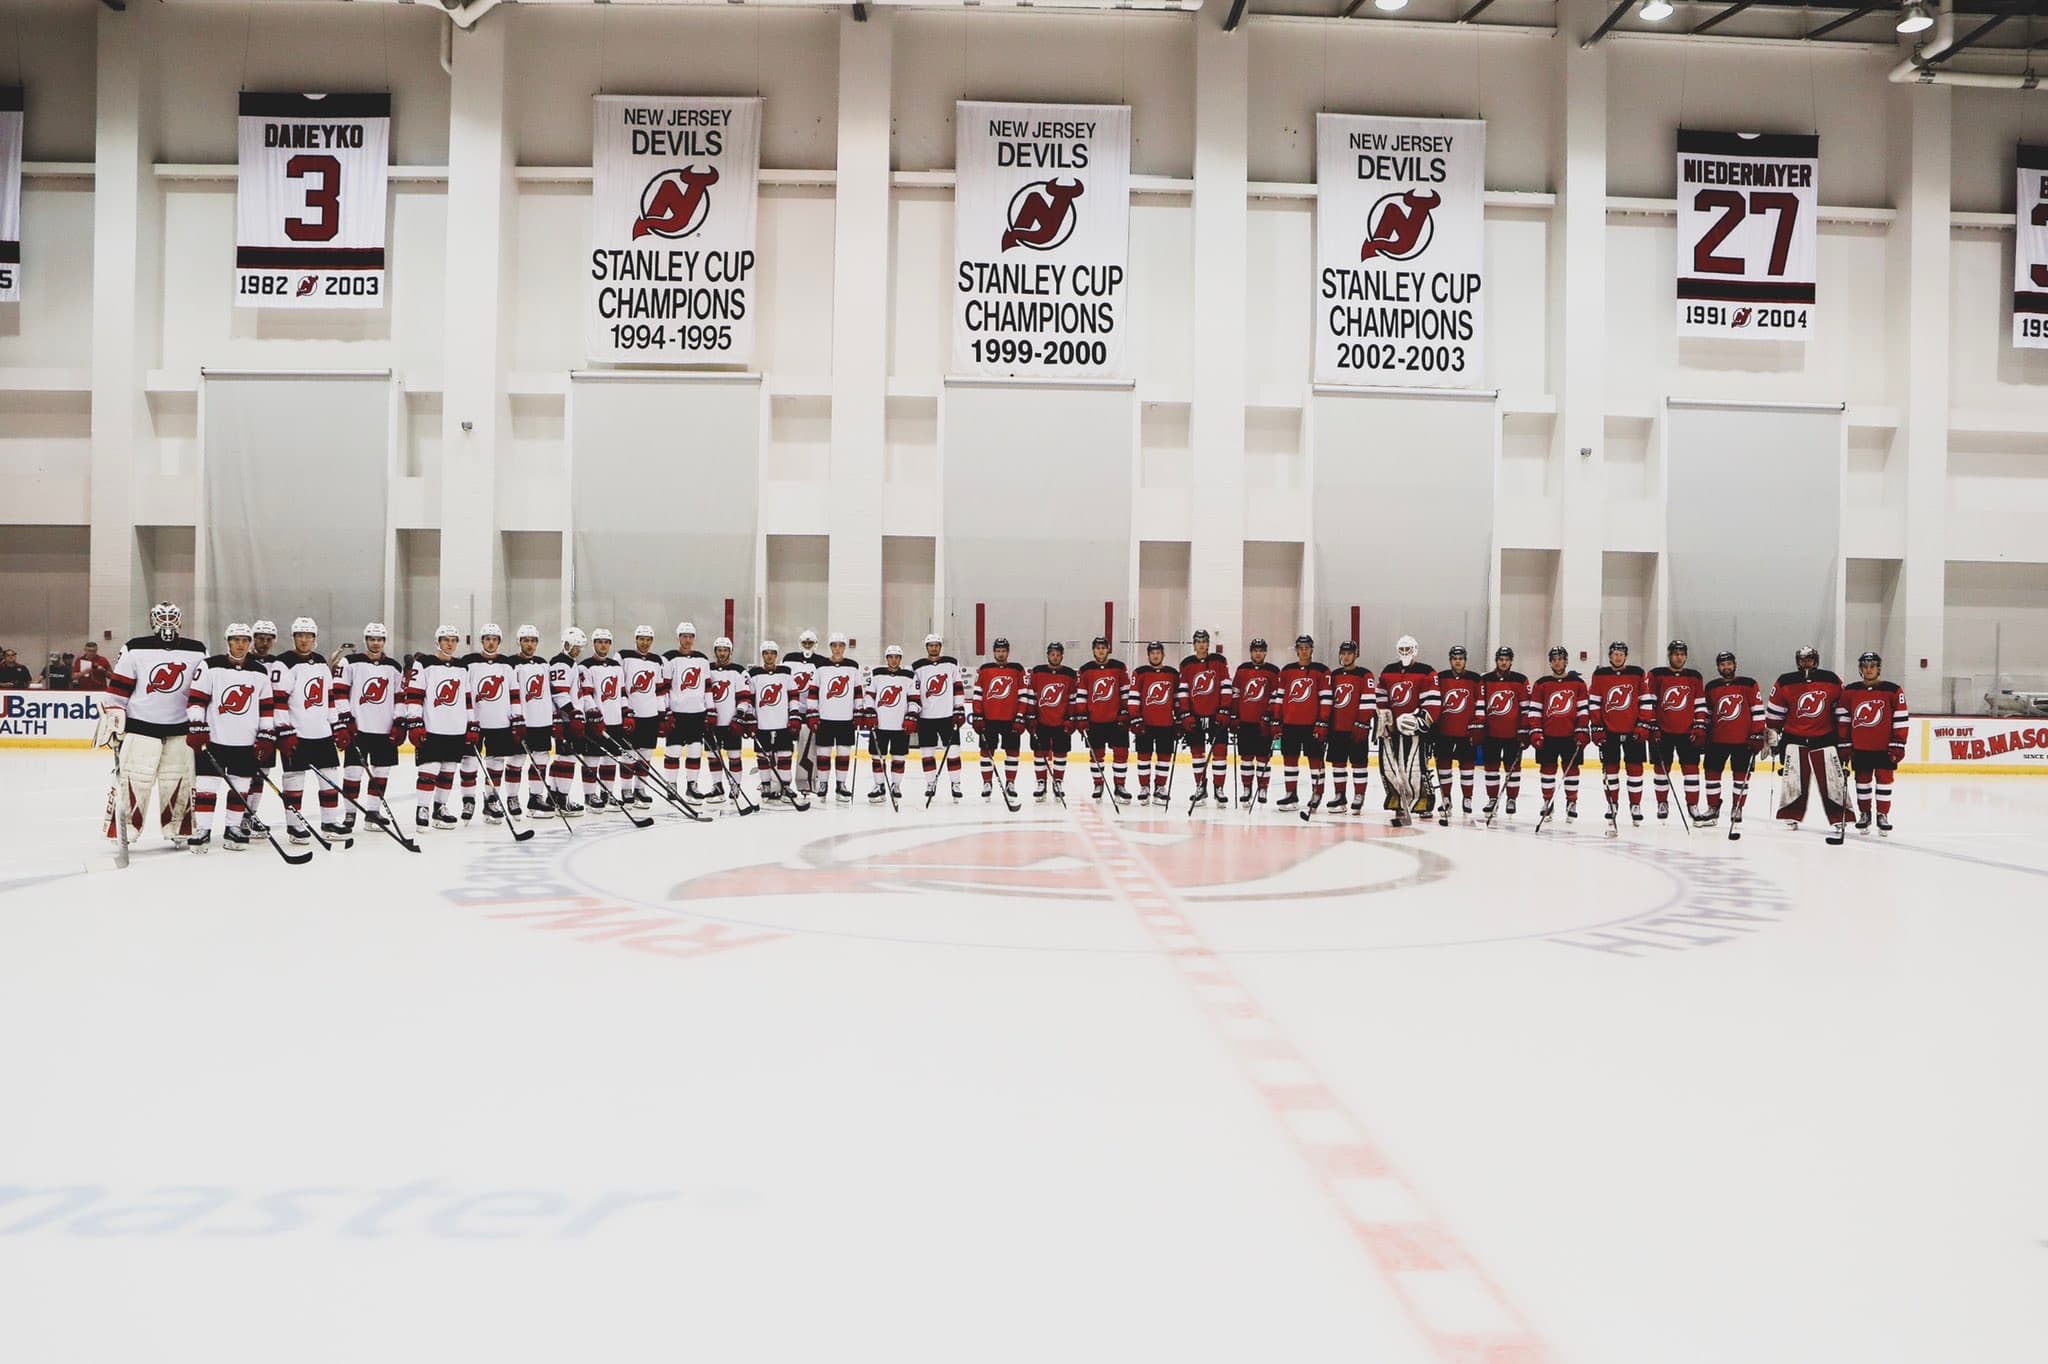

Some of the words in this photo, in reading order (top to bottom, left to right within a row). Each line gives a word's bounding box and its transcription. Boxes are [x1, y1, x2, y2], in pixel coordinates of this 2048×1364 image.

[624, 108, 664, 126] NEW
[667, 109, 732, 127] JERSEY
[990, 120, 1028, 138] NEW
[1032, 121, 1096, 139] JERSEY
[264, 123, 364, 149] DANEYKO
[632, 129, 722, 156] DEVILS
[1350, 133, 1388, 150] NEW
[1391, 135, 1453, 153] JERSEY
[998, 141, 1088, 169] DEVILS
[1358, 154, 1446, 183] DEVILS
[1684, 159, 1812, 188] NIEDERMAYER
[285, 154, 341, 242] 3
[1694, 189, 1800, 276] 27
[592, 249, 699, 282] STANLEY
[705, 250, 754, 282] CUP
[958, 261, 1066, 295] STANLEY
[1072, 265, 1123, 297] CUP
[241, 276, 288, 295] 1982
[326, 277, 378, 295] 2003
[1322, 268, 1425, 302] STANLEY
[1432, 272, 1482, 303] CUP
[599, 287, 745, 320] CHAMPIONS
[965, 300, 1113, 333] CHAMPIONS
[1686, 306, 1726, 325] 1991
[1757, 309, 1807, 328] 2004
[611, 324, 731, 350] 1994-1995
[1330, 305, 1473, 341] CHAMPIONS
[972, 339, 1106, 365] 1999-2000
[1337, 343, 1464, 372] 2002-2003
[1934, 728, 1954, 737] WHO
[1957, 728, 1974, 737] BUT
